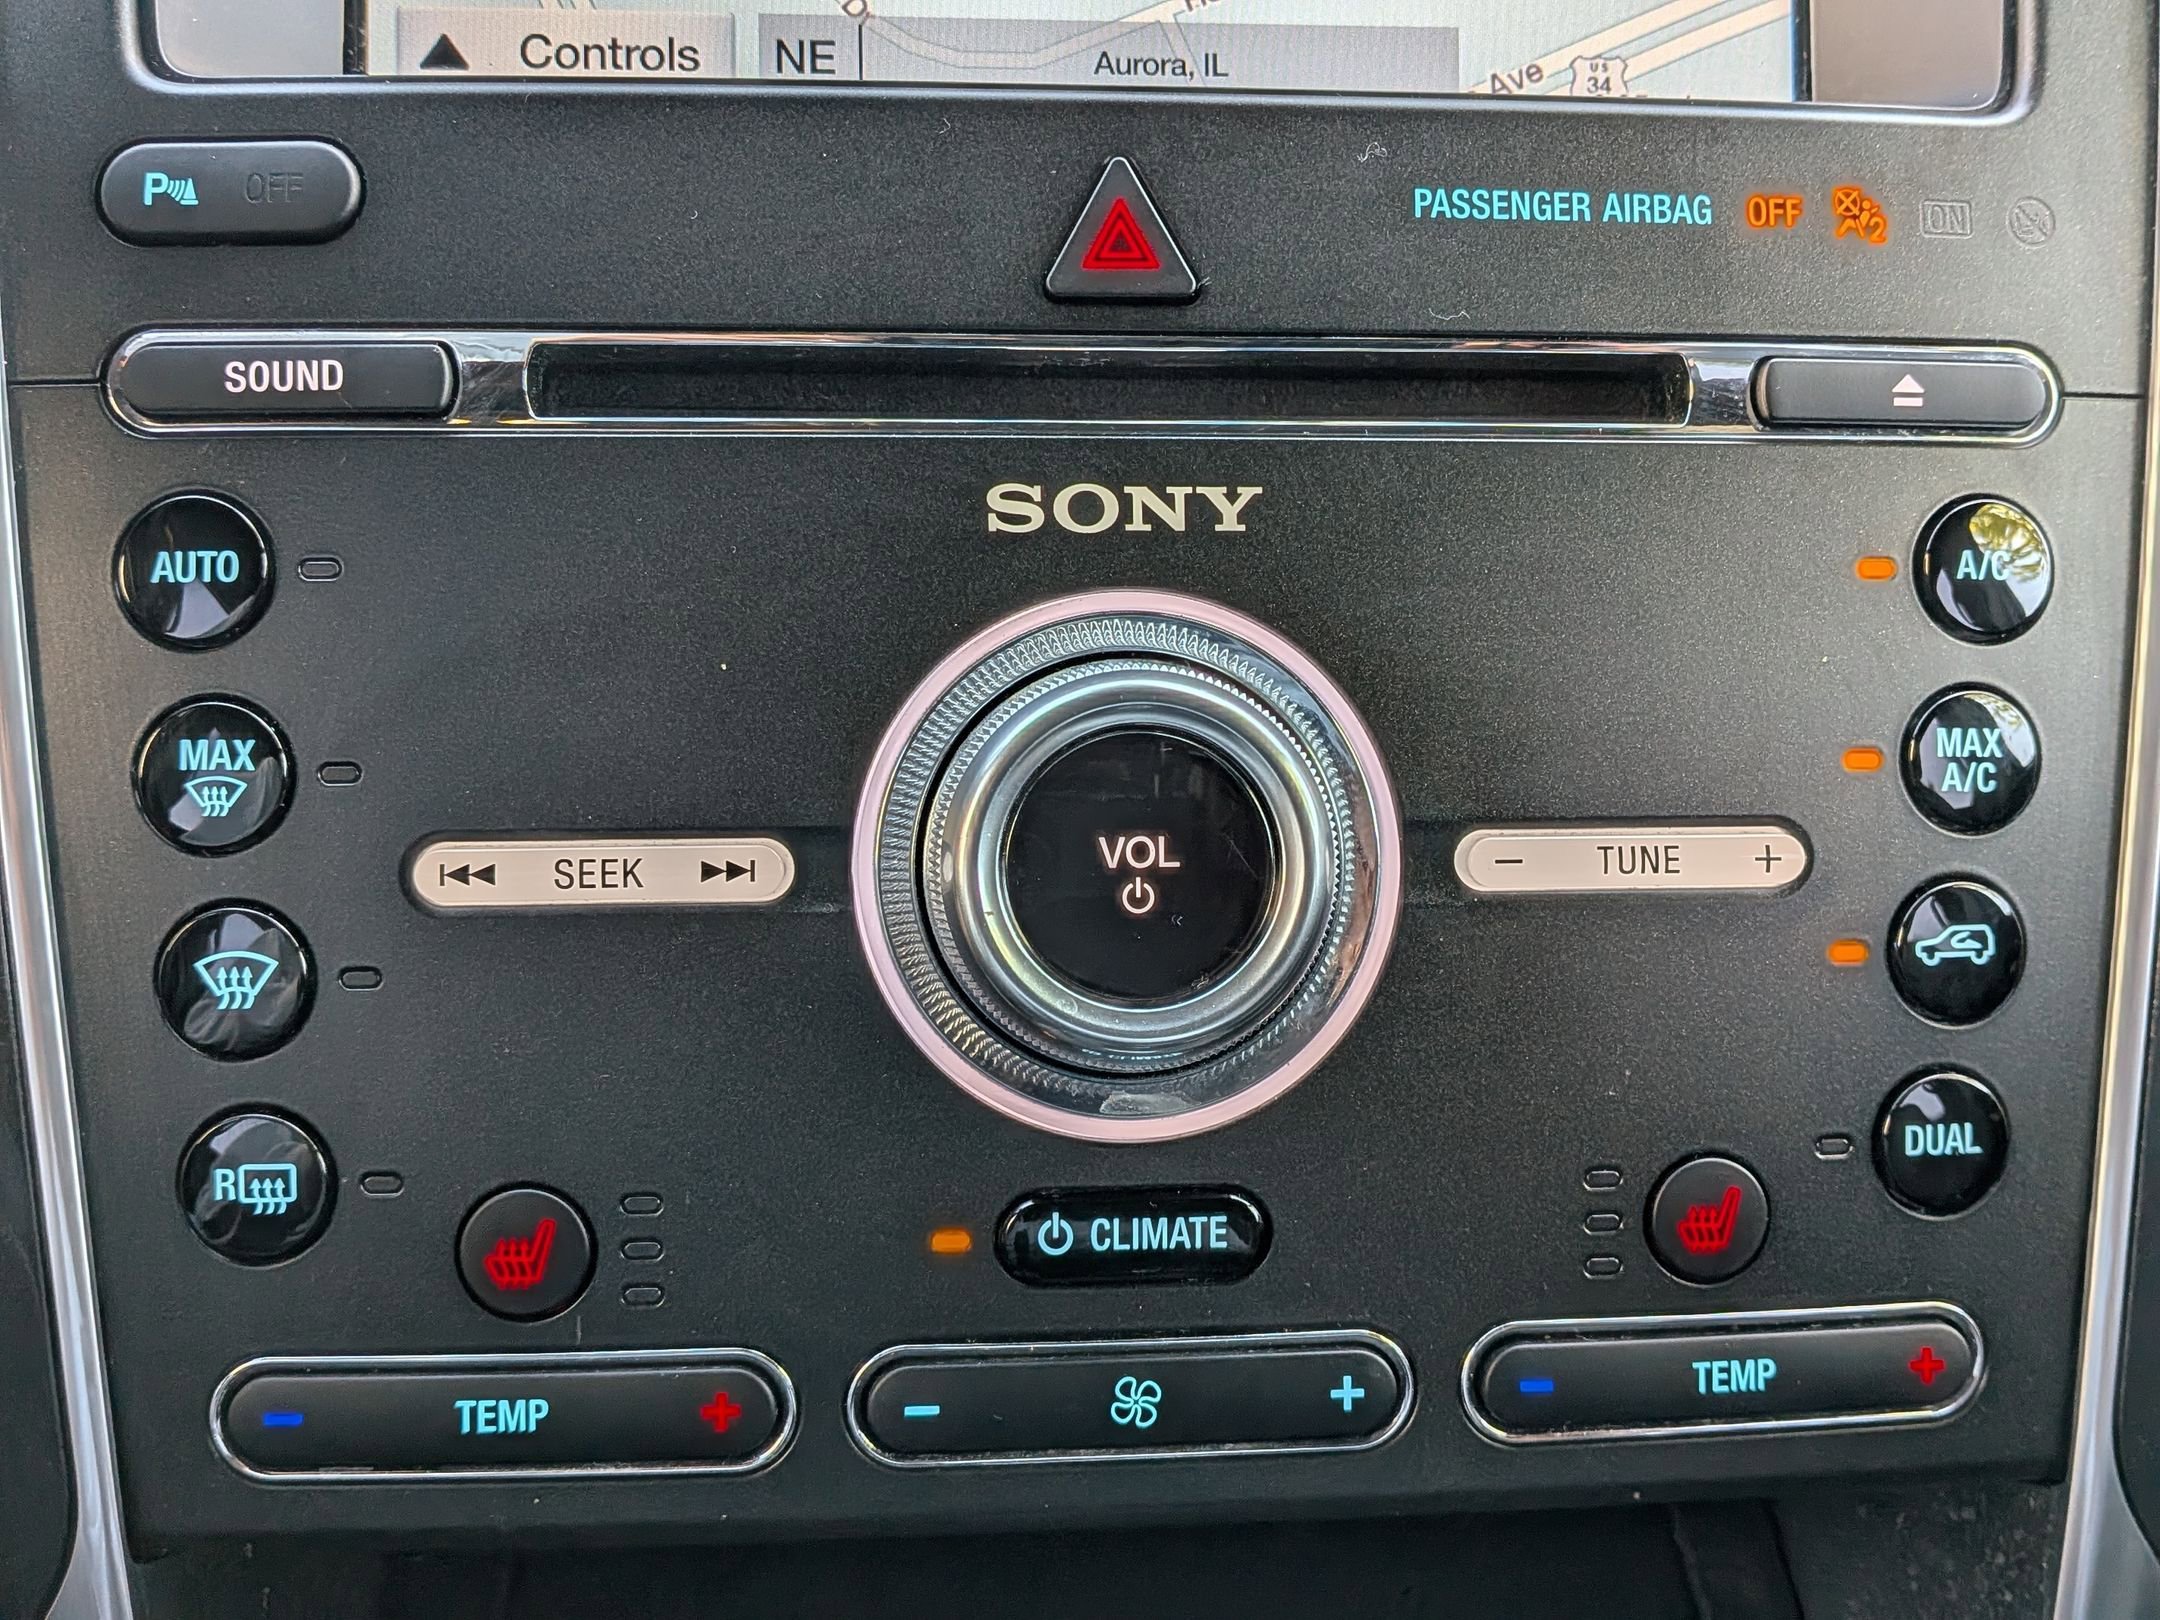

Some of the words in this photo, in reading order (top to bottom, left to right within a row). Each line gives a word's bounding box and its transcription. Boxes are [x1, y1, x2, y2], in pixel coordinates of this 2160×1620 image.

[520, 33, 700, 71] Controls
[776, 39, 836, 75] NE
[1094, 50, 1194, 81] Aurora,
[1204, 53, 1229, 77] IL
[1489, 63, 1544, 95] Ave
[1586, 76, 1612, 94] 34
[245, 172, 304, 205] OFF
[1413, 188, 1592, 222] PASSENGER
[1602, 192, 1713, 225] AIRBAG
[1748, 195, 1802, 227] OFF
[1926, 202, 1965, 233] ON
[224, 359, 344, 393] SOUND
[986, 483, 1263, 534] SONY
[150, 550, 240, 584] AUTO
[1955, 549, 2010, 581] A/C
[178, 738, 256, 771] MAX
[1935, 727, 2003, 758] MAX
[1941, 761, 1998, 793] A/C
[1098, 835, 1181, 869] VOL
[1596, 844, 1681, 875] TUNE
[553, 858, 644, 889] SEEK
[1904, 1121, 1984, 1157] DUAL
[1090, 1215, 1228, 1252] CLIMATE
[1692, 1357, 1777, 1394] TEMP
[454, 1398, 549, 1435] TEMP
